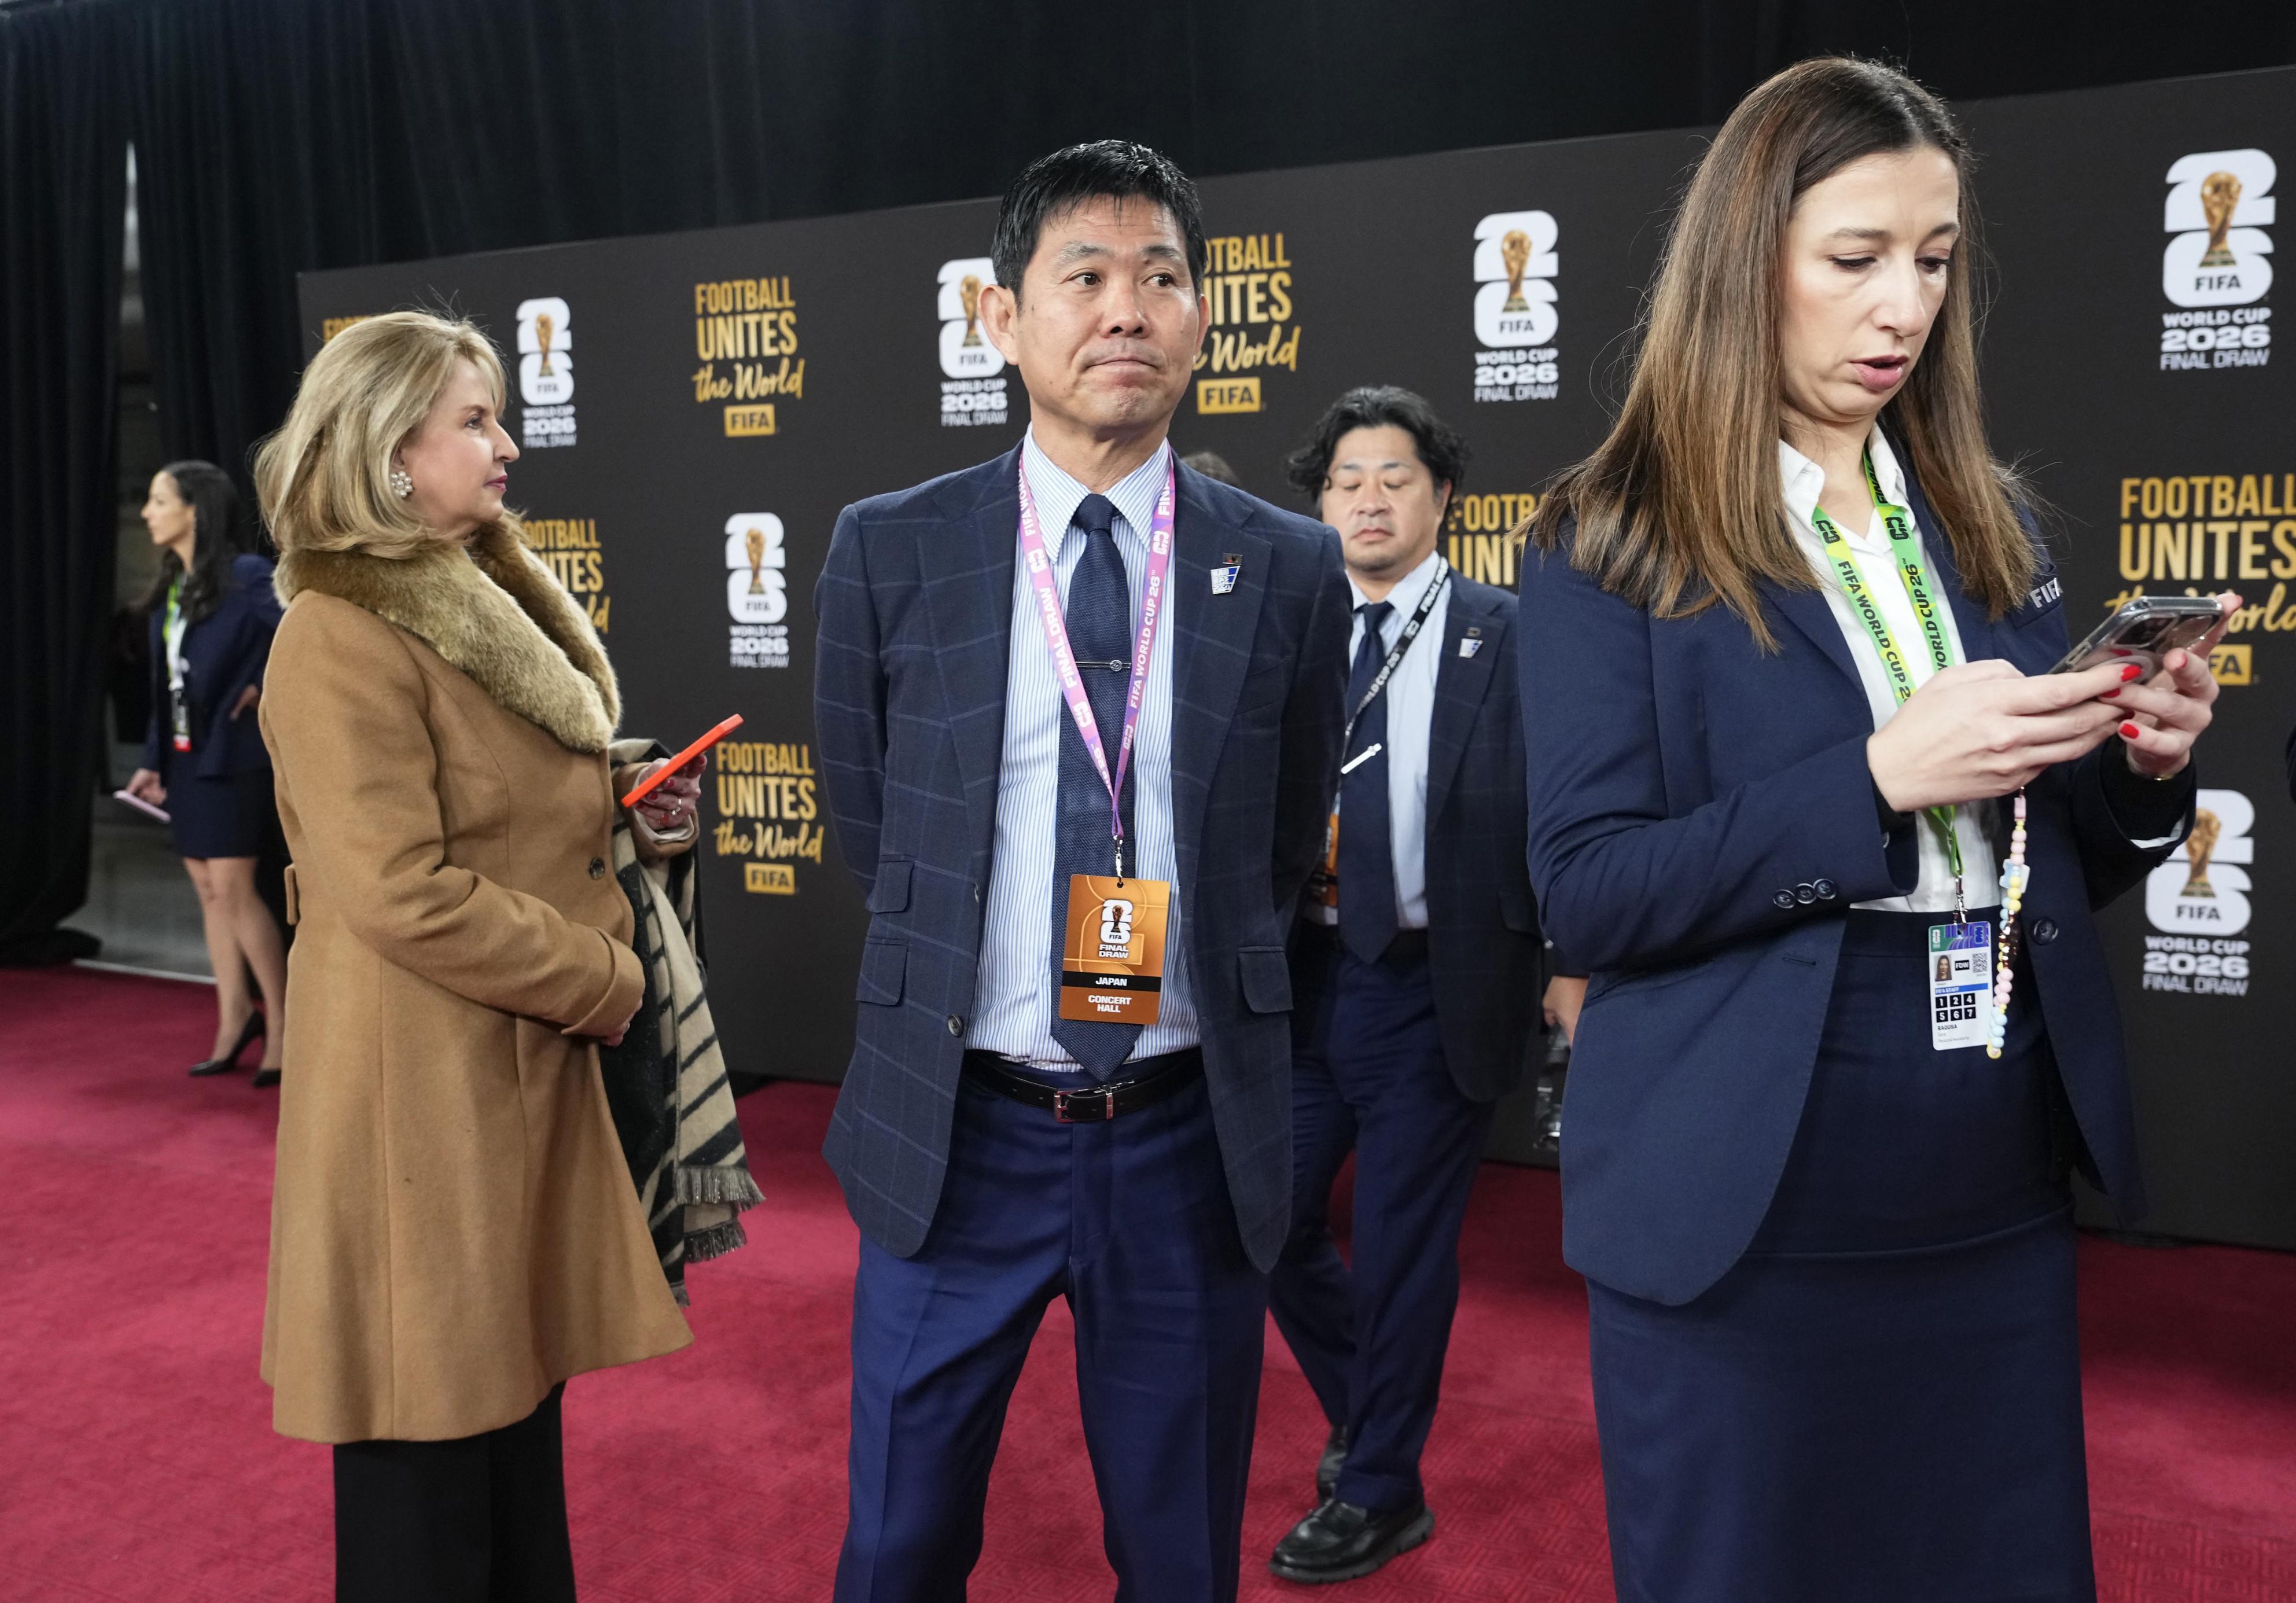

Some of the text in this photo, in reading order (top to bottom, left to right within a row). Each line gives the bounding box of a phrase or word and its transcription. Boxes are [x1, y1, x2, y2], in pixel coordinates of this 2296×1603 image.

[1205, 232, 1292, 273] TBALL
[2195, 274, 2240, 291] FIFA
[694, 275, 796, 315] FOOTBALL
[1203, 271, 1292, 326] ITES
[1499, 319, 1535, 334] FIFA
[2162, 307, 2272, 328] WORLD CUP
[696, 310, 798, 361] UNITES
[2161, 323, 2271, 352] 2026
[959, 353, 988, 365] FIFA
[1211, 323, 1301, 373] World
[1474, 347, 1559, 366] WORLD CUP
[2160, 348, 2270, 371] FINAL DRAW
[690, 356, 806, 403] the World
[1474, 362, 1559, 386] 2026
[940, 378, 1007, 394] WORLD CUP
[1205, 386, 1253, 406] FIFA
[1474, 383, 1559, 403] FINAL DRAW
[522, 405, 576, 418] WORLD CUP
[941, 391, 1007, 413] 2026
[523, 416, 577, 436] 2026
[731, 411, 770, 430] FIFA
[941, 410, 1008, 427] FINAL DRAW
[2121, 473, 2296, 520] FOOTBALL
[522, 519, 601, 550] OOTBALL
[2119, 519, 2296, 581] UNITES
[538, 550, 604, 593] ITES
[1914, 589, 1933, 618] CUP
[2029, 577, 2063, 608] FIFA
[1144, 598, 1157, 626] CUP
[730, 624, 789, 637] WORLD CUP
[1039, 587, 1077, 689] FINAL DRAW
[1838, 561, 1911, 703] FIFA WORLD CUP 2
[730, 637, 789, 655] 2026
[1135, 627, 1151, 676] WORLD
[1130, 679, 1142, 709] FIFA
[715, 741, 815, 775] FOOTBALL
[717, 774, 817, 821] UNITES
[712, 819, 825, 865] the World
[752, 869, 790, 886] FIFA
[2175, 904, 2221, 921] FIFA
[1099, 944, 1129, 953] FINAL
[1099, 951, 1129, 959] DRAW
[2144, 935, 2251, 955] WORLD CUP
[2143, 951, 2250, 979] 2026
[1095, 977, 1127, 987] JAPAN
[2142, 973, 2250, 997] FINAL DRAW
[1088, 995, 1132, 1005] CONCERT
[1097, 1004, 1121, 1013] HALL
[1940, 995, 1973, 1006] 1 2 4
[1940, 1009, 1973, 1020] 5 6 7
